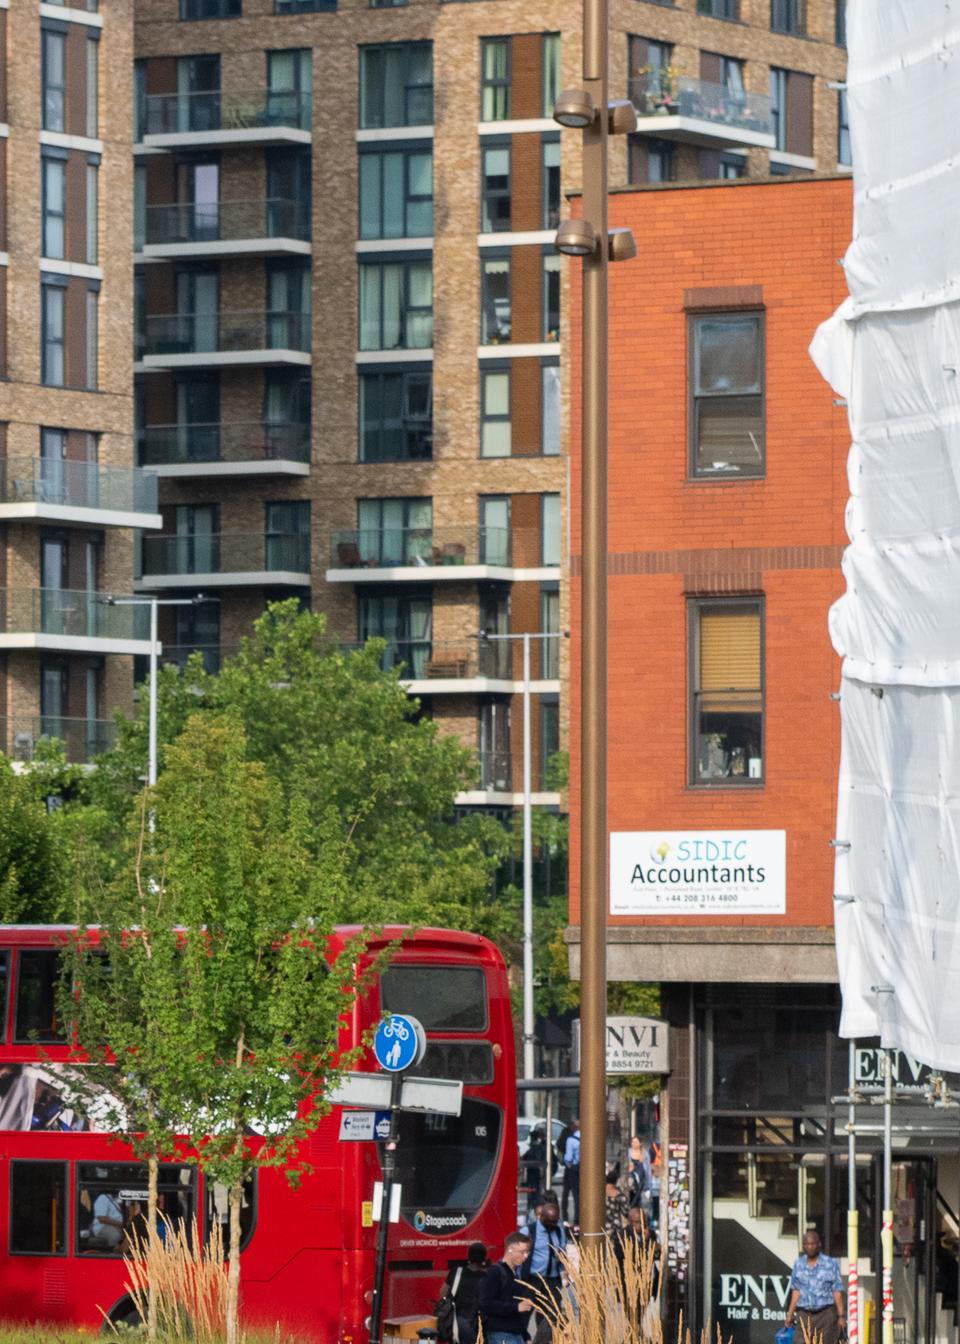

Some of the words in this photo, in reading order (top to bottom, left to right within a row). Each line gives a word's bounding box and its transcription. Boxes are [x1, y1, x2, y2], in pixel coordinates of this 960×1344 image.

[677, 840, 747, 862] SIDIC
[630, 863, 766, 884] Accountants
[719, 894, 738, 902] 4800
[606, 1025, 658, 1048] NVI
[622, 1050, 650, 1059] Beauty
[611, 1060, 633, 1069] 8854
[635, 1060, 654, 1069] 9721
[855, 1048, 924, 1082] ENV
[425, 1214, 467, 1229] Stagecoach
[719, 1273, 792, 1308] ENV
[727, 1307, 749, 1320] Hair
[751, 1307, 760, 1320] &
[762, 1308, 787, 1321] Beau
